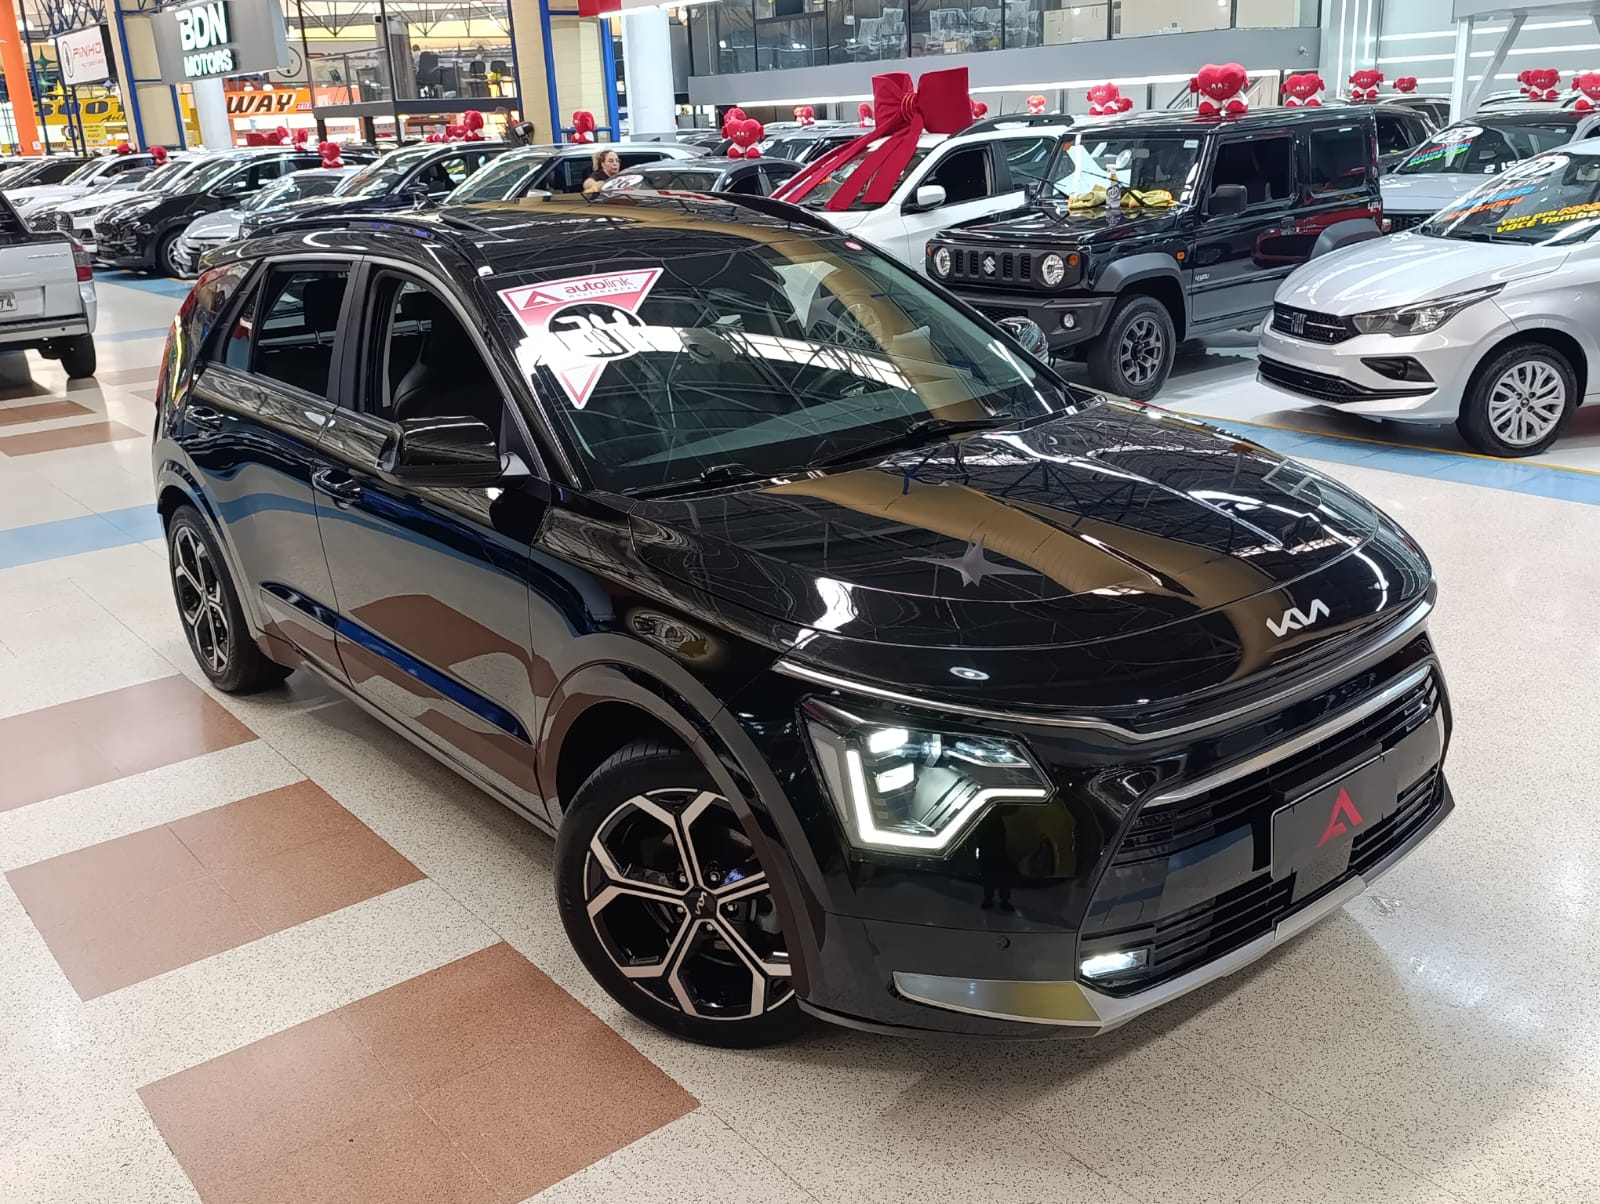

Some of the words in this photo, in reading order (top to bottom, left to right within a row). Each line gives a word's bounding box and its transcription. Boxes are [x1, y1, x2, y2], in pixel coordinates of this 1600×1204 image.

[175, 1, 228, 51] BDN
[184, 48, 233, 77] MOTORS
[227, 92, 296, 114] WAY
[564, 277, 634, 294] autolink
